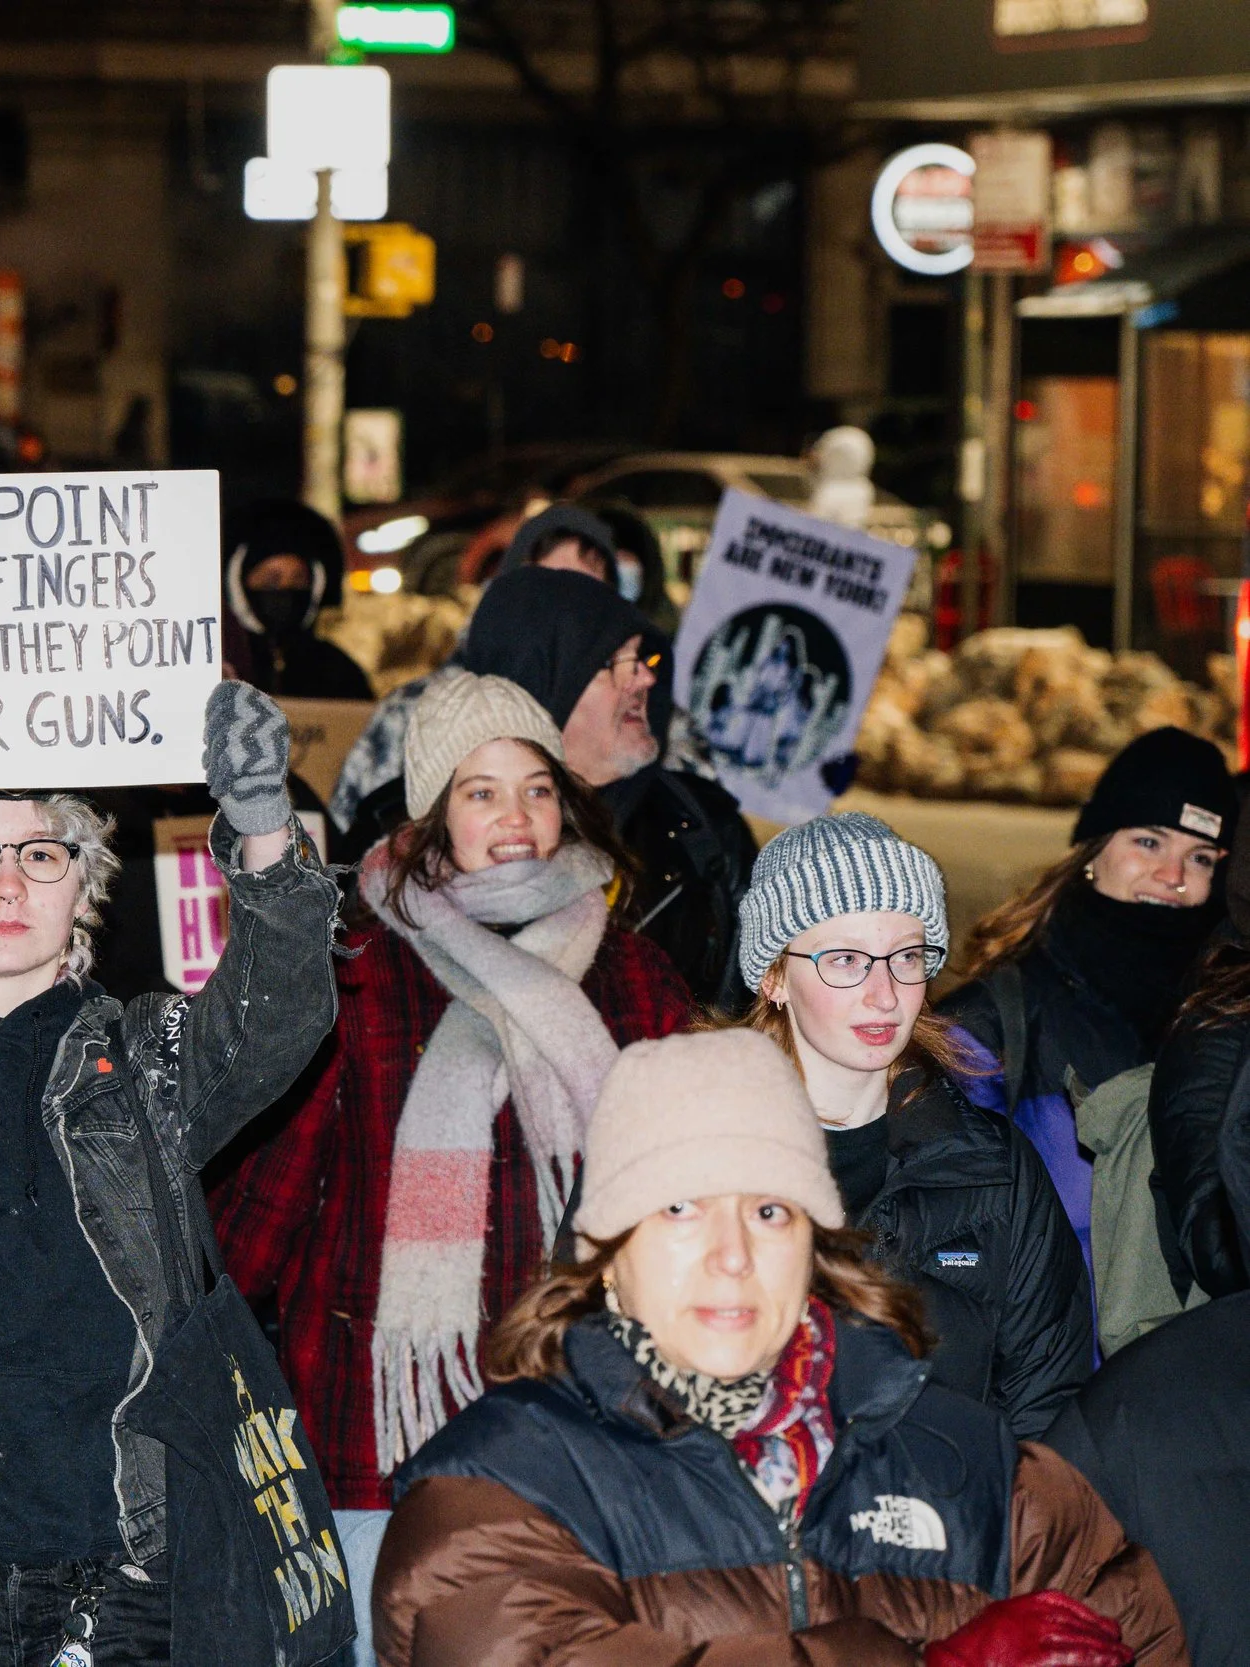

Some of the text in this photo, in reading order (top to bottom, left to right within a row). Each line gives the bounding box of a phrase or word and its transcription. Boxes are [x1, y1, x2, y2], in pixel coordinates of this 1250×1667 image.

[104, 616, 217, 669] POINT
[26, 689, 163, 748] GUNS.
[873, 1494, 910, 1512] THE
[849, 1509, 912, 1532] NORTH
[871, 1529, 913, 1549] FACE
